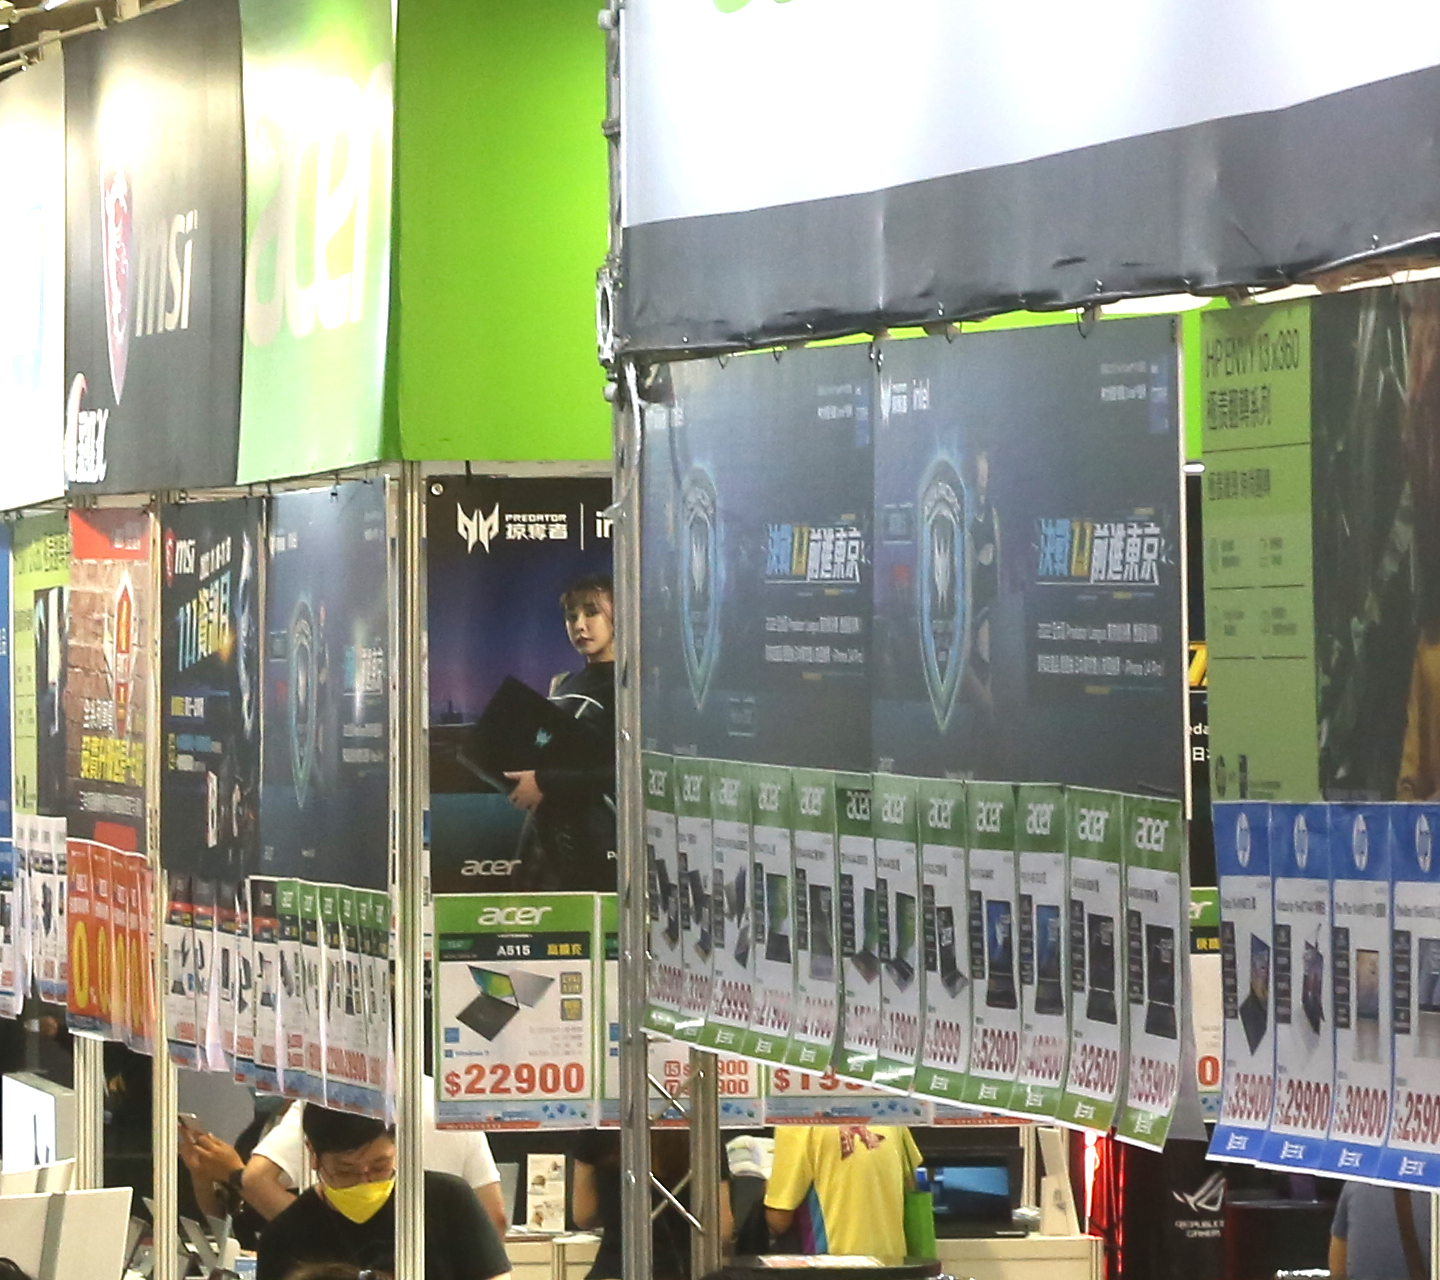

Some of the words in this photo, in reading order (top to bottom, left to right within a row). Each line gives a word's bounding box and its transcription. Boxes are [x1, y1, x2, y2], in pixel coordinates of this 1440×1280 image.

[505, 513, 568, 523] PREDATOR
[461, 858, 522, 876] acer
[477, 905, 553, 927] acer
[496, 946, 531, 957] A515
[444, 1062, 586, 1097] $22900
